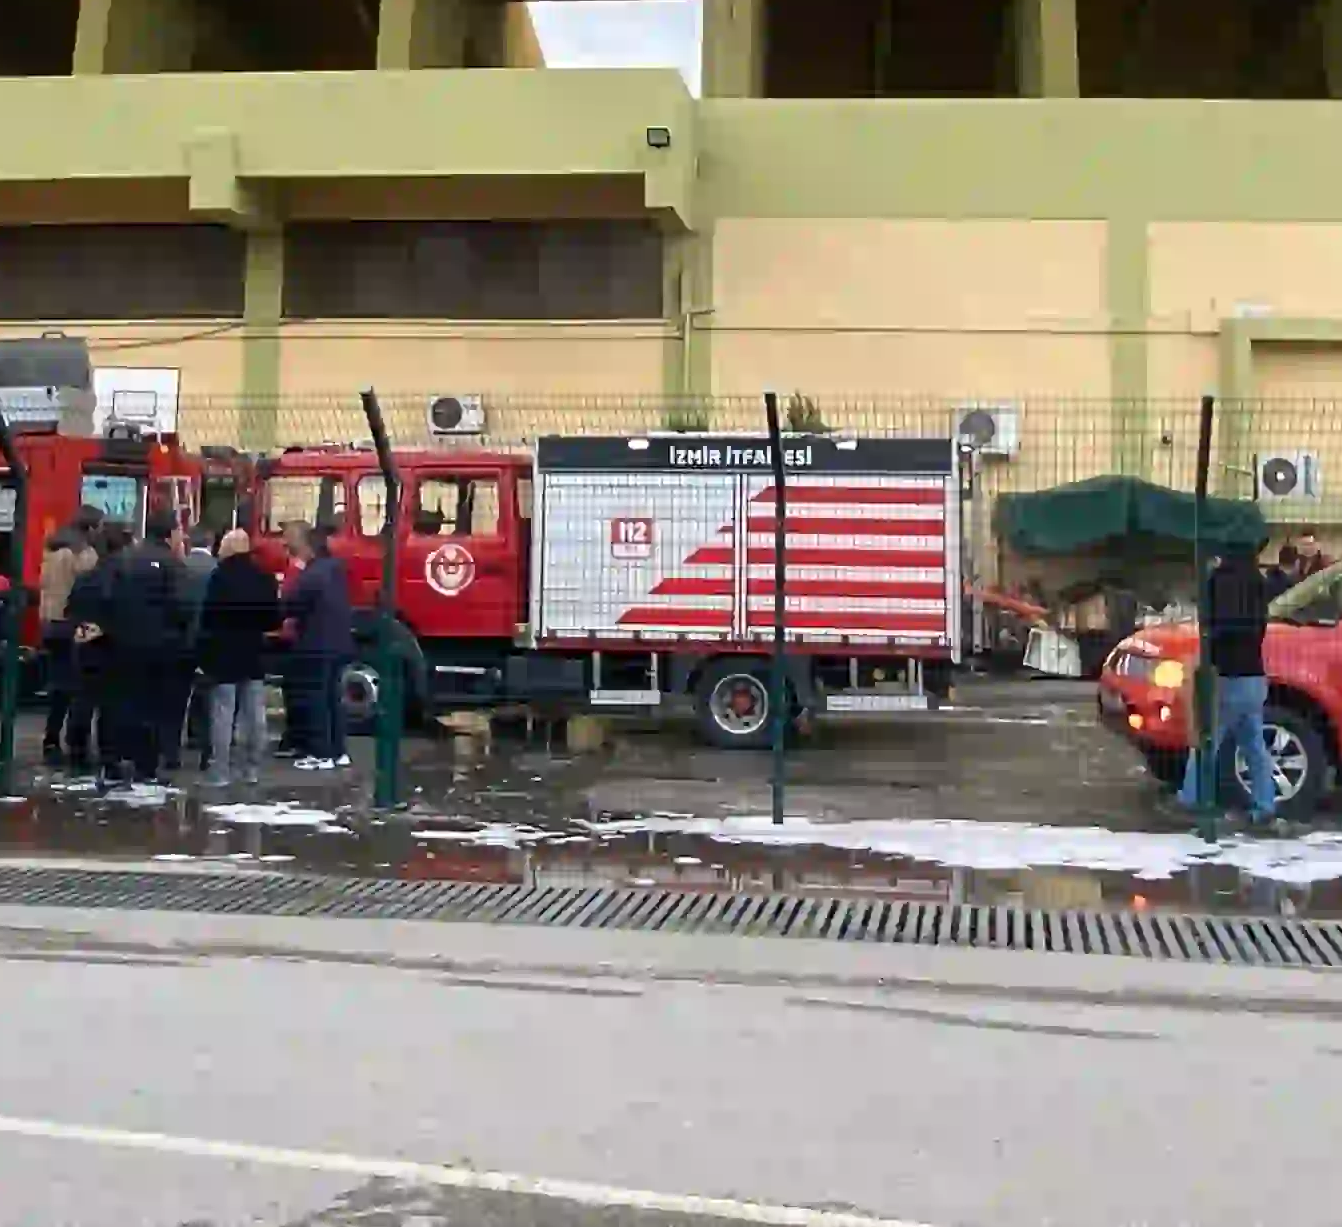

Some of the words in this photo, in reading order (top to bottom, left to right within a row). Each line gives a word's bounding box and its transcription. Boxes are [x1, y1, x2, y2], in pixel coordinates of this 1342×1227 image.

[669, 445, 722, 466] İZMİR
[726, 445, 812, 466] İTFAİESİ
[619, 521, 648, 543] 112
